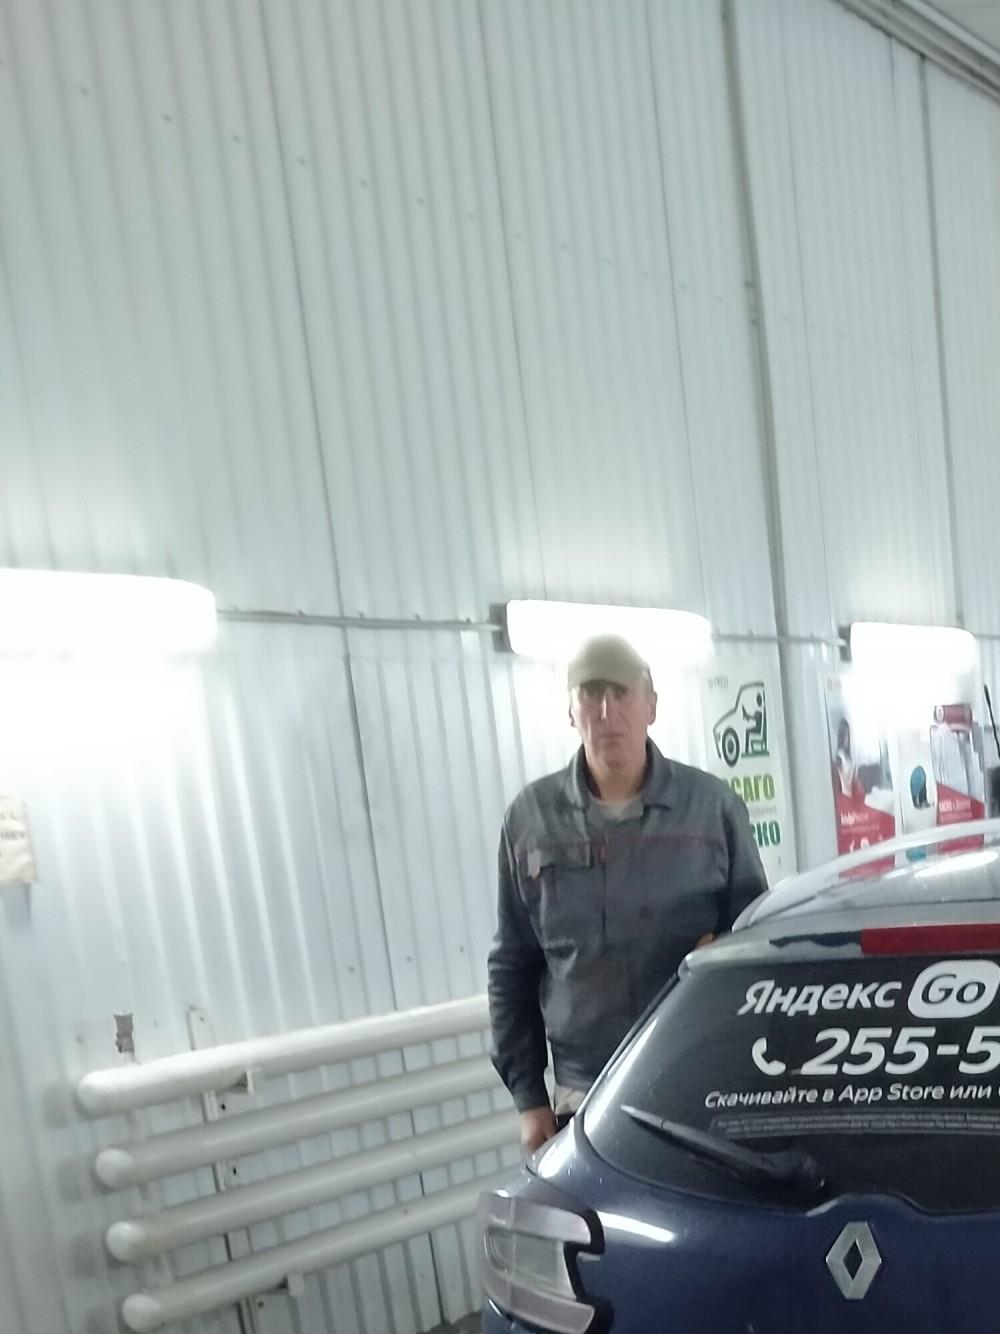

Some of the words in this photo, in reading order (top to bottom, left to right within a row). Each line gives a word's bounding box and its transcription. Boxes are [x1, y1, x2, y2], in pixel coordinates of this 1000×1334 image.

[725, 774, 776, 802] САГО
[737, 979, 902, 1017] Яндекс
[921, 973, 987, 1004] Go
[704, 1086, 819, 1109] Скачивайте
[822, 1088, 835, 1099] в
[838, 1084, 883, 1105] App
[887, 1083, 945, 1101] Store
[949, 1085, 992, 1100] или
